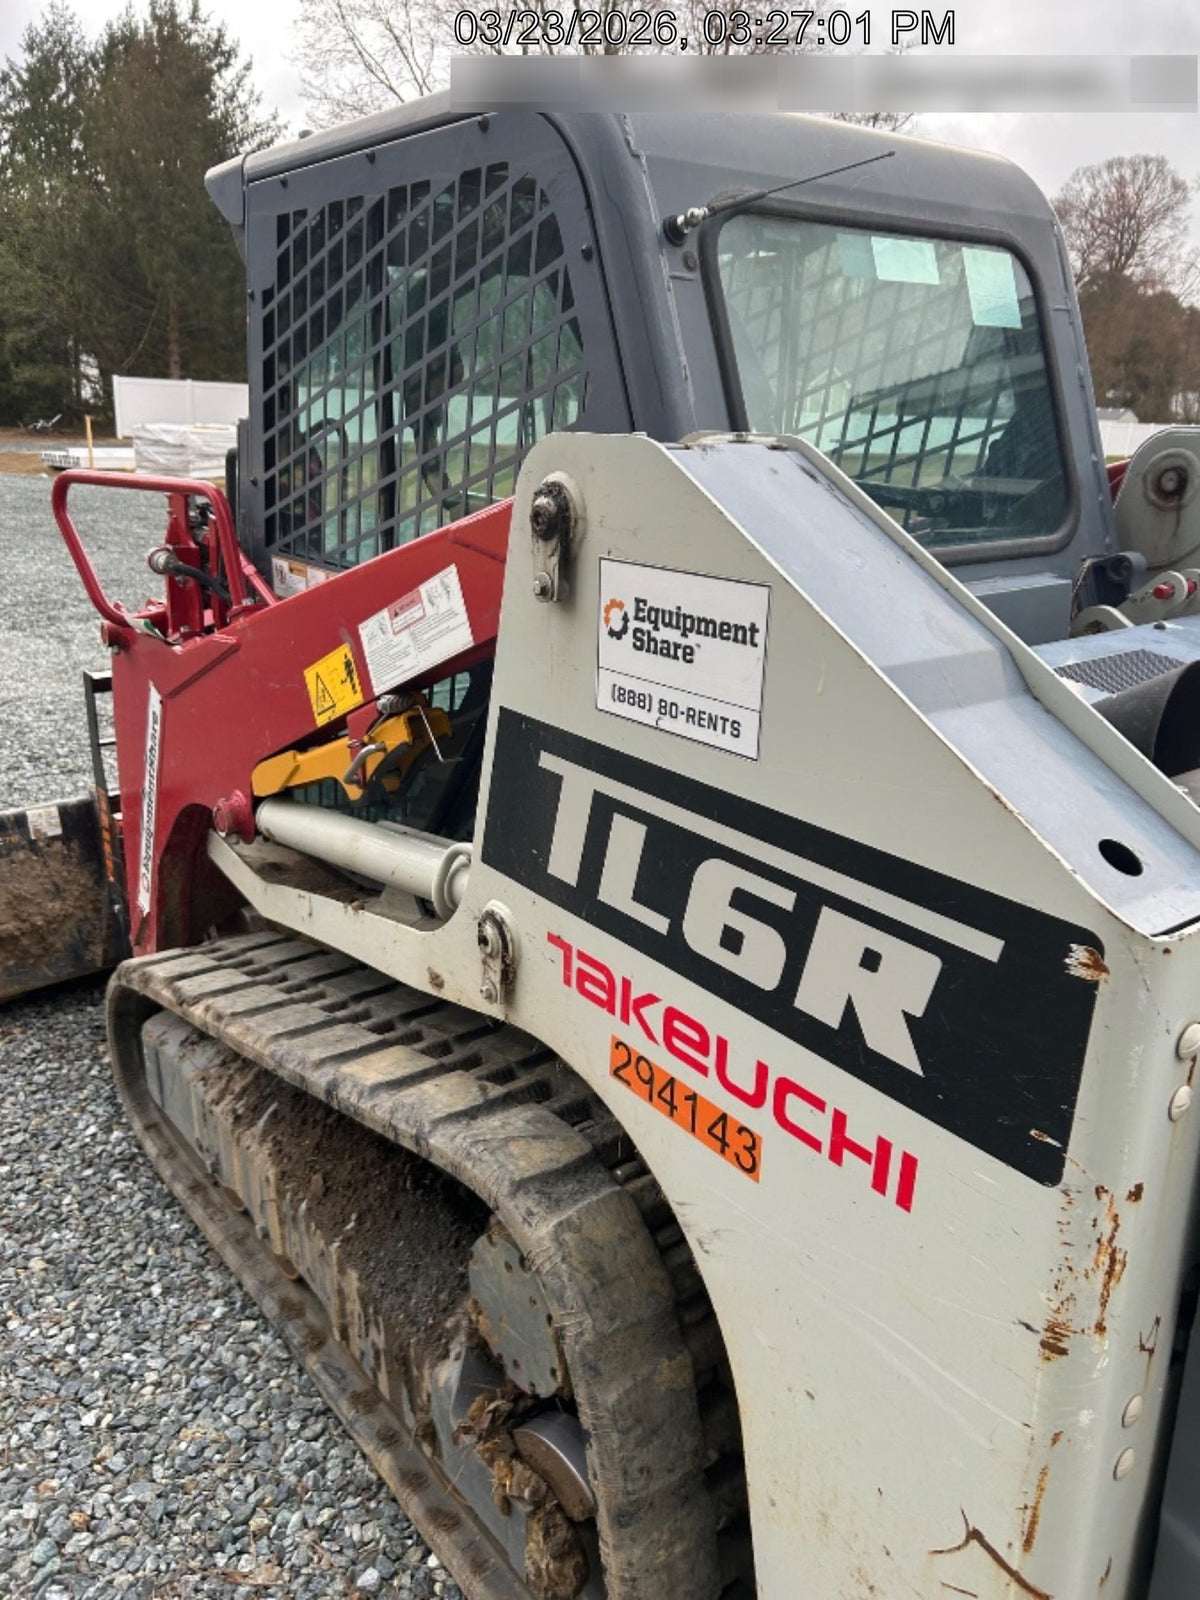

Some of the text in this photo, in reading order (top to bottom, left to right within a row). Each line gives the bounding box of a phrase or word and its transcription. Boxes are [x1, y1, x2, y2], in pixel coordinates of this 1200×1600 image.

[633, 597, 760, 648] Equipment
[611, 683, 742, 739] (888) 80-RENTS
[538, 750, 1006, 1078] TL6R
[613, 1041, 757, 1174] 294143
